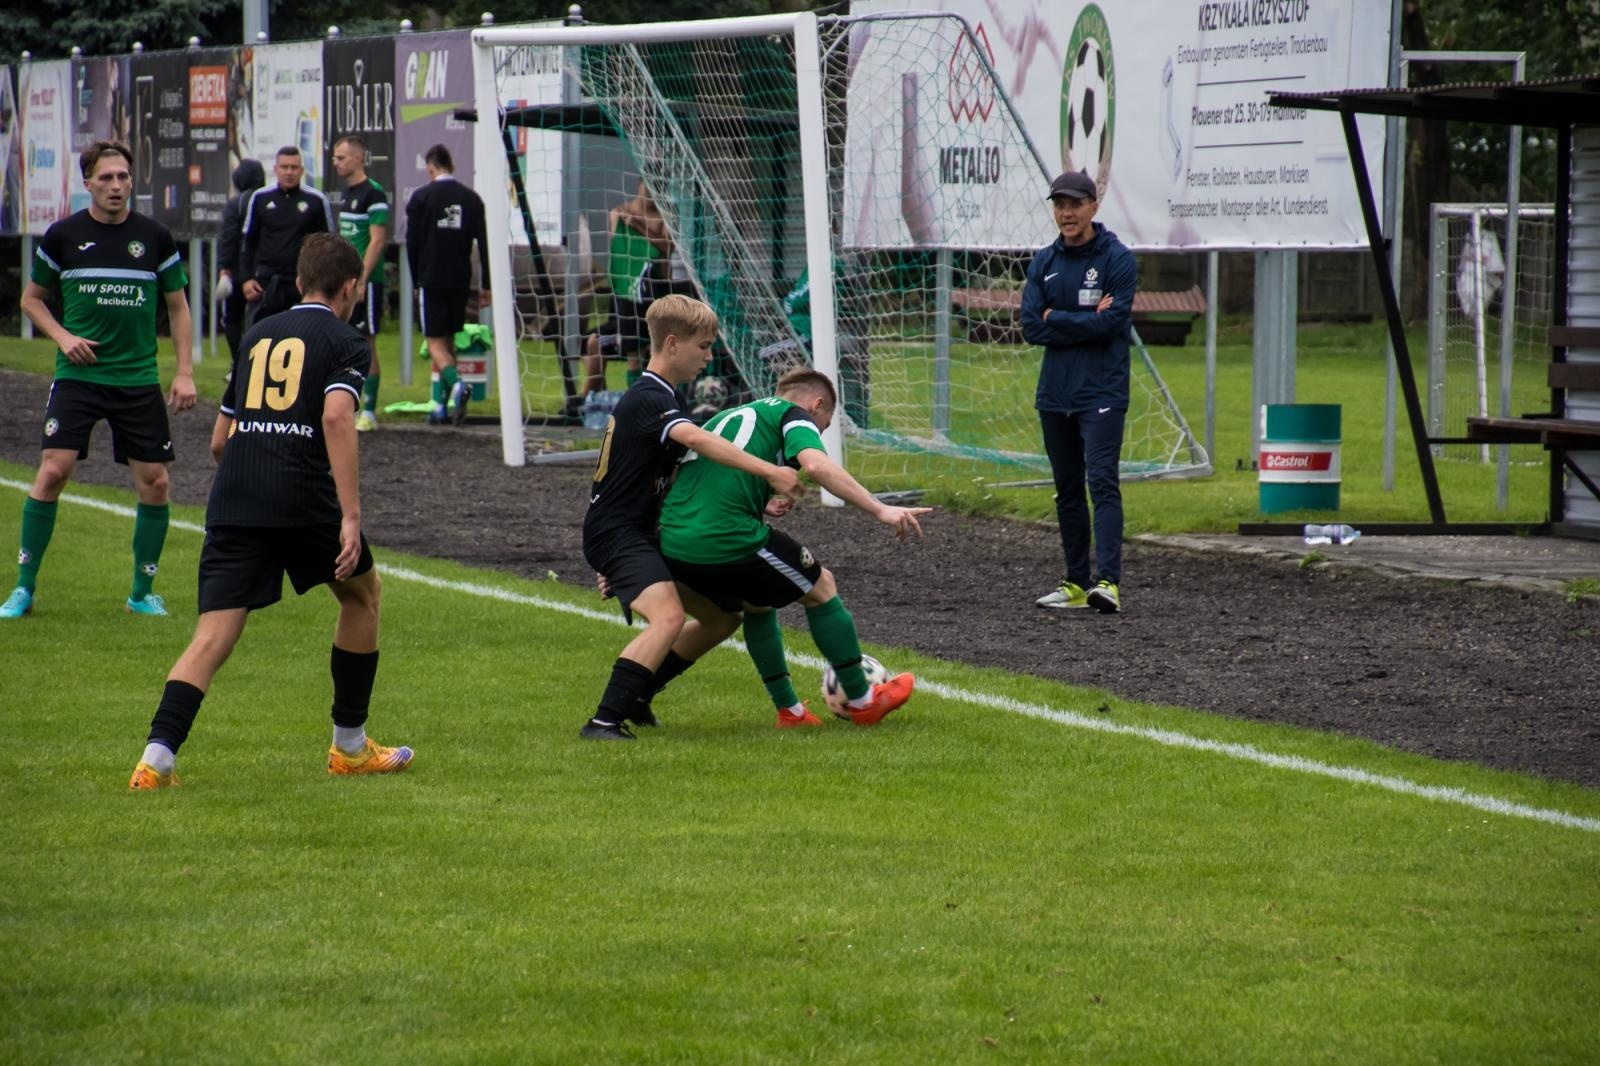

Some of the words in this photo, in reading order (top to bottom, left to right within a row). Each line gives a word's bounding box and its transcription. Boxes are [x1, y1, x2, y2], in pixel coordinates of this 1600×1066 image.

[1198, 1, 1250, 32] KRZYKAŁA
[1290, 32, 1328, 56] Trockenbau
[1191, 105, 1223, 126] Plauener
[940, 146, 1000, 184] METALIO
[99, 283, 136, 295] SPORT
[244, 336, 306, 412] 19
[238, 421, 314, 438] UNIWAR
[1274, 455, 1310, 468] Castrol
